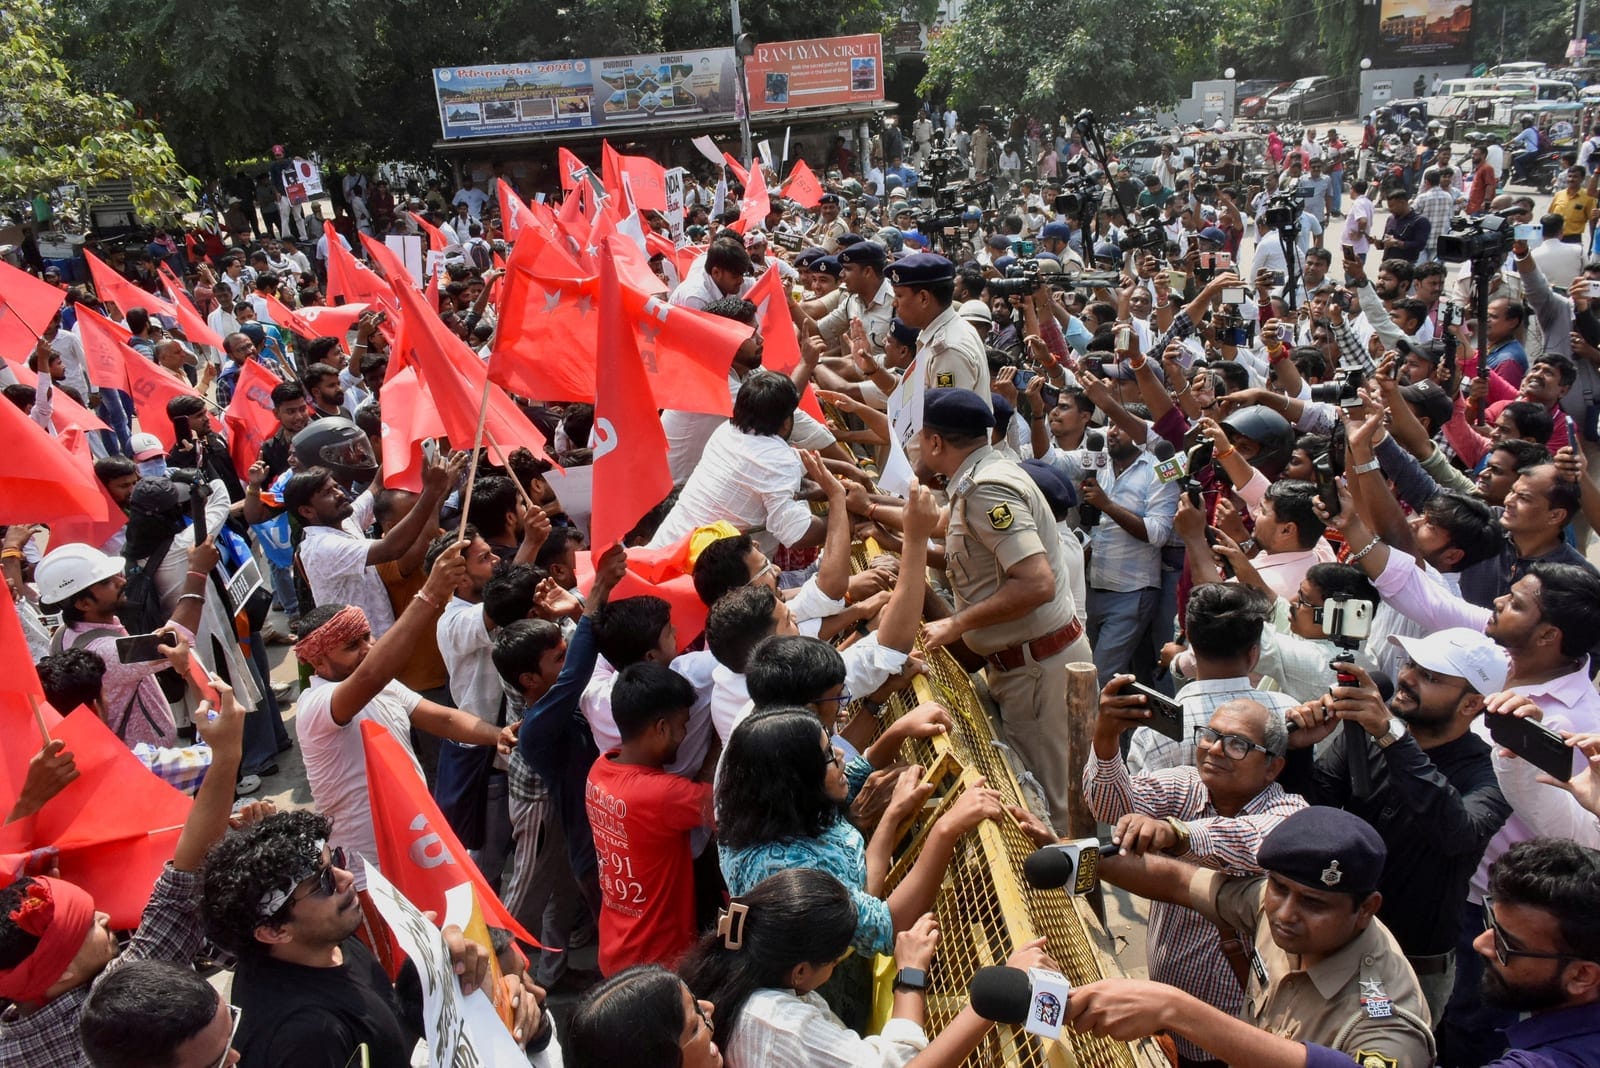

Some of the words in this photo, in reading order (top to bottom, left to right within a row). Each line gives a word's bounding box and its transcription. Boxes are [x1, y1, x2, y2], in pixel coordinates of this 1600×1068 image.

[660, 55, 683, 65] CIRCUIT
[758, 43, 830, 63] RAMAYAN
[611, 852, 636, 879] 91
[615, 877, 648, 904] 92
